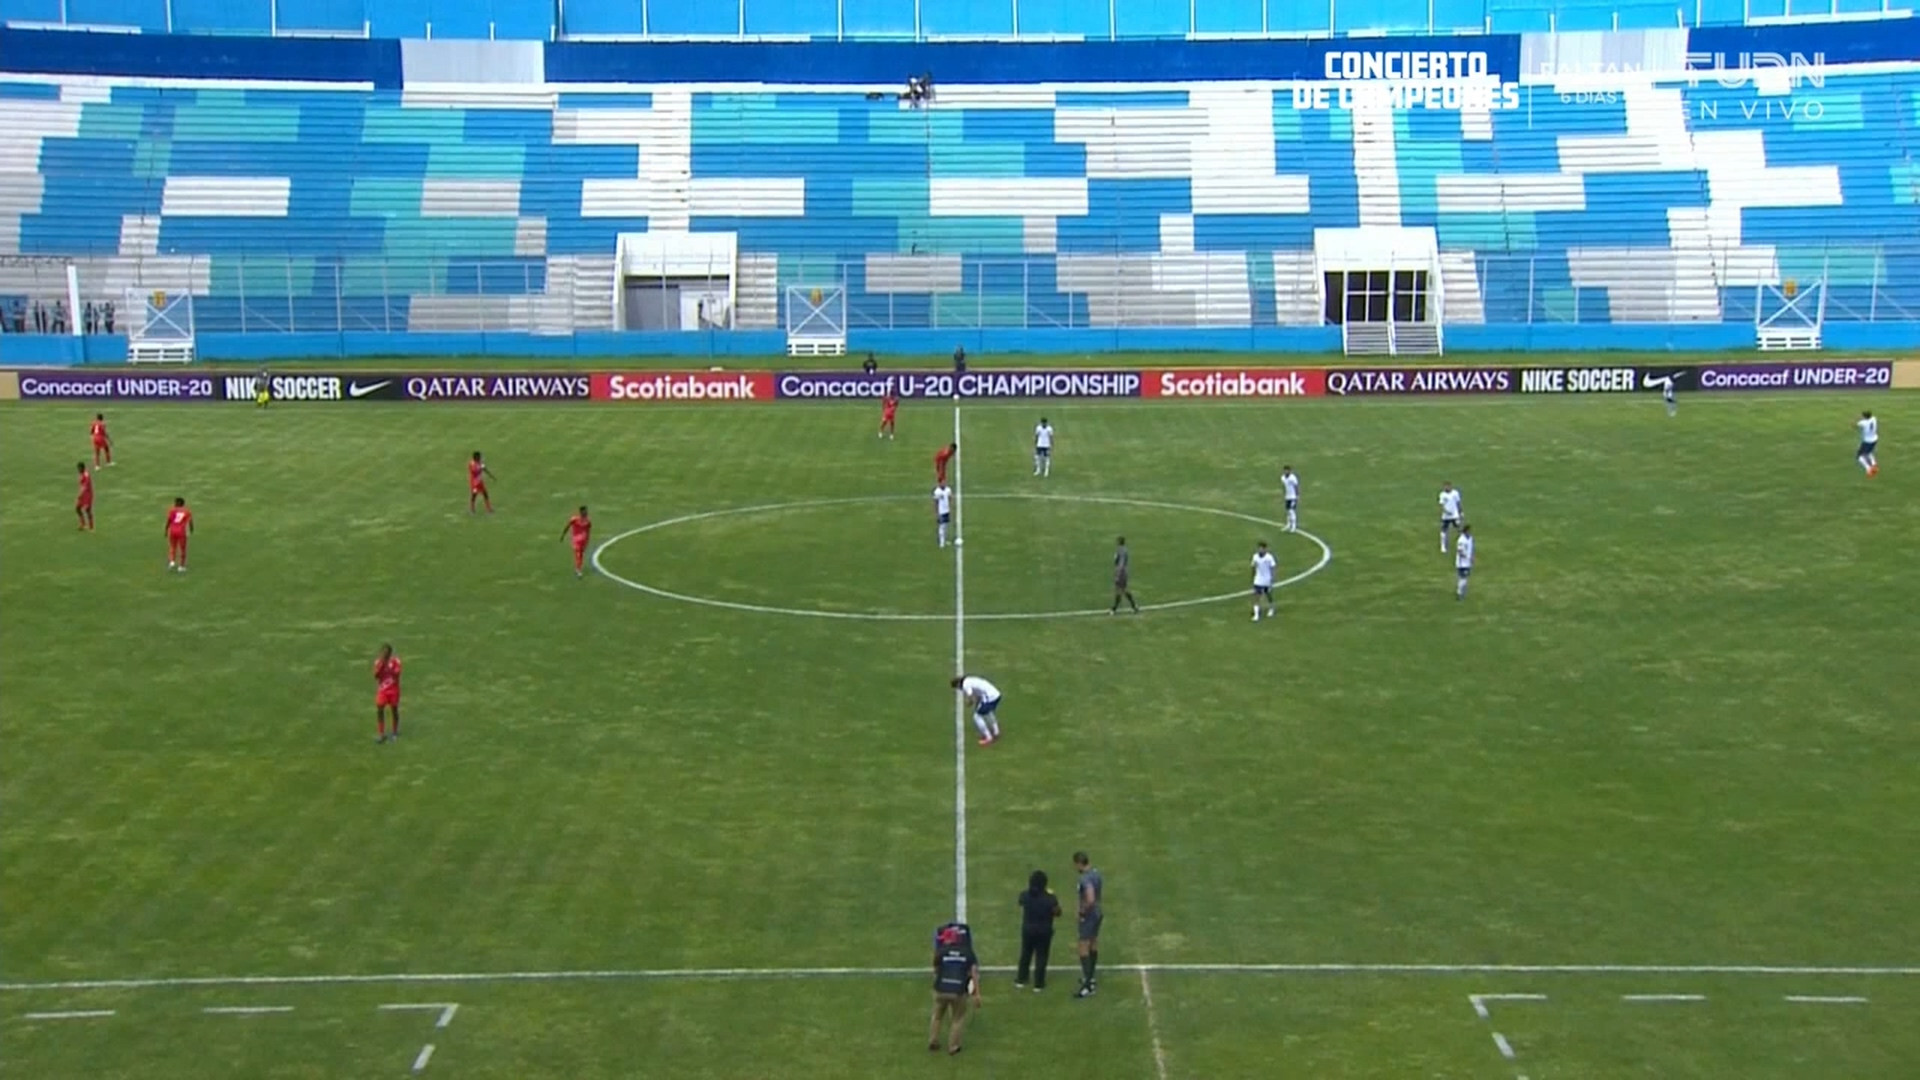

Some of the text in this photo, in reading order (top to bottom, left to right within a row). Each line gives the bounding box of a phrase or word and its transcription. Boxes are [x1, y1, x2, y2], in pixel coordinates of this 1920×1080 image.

[22, 378, 212, 395] Concacaf UNDER-20
[225, 377, 341, 399] NIK SOCCER
[610, 375, 754, 398] Scotiabank
[781, 375, 1139, 396] Concacaf U-20 CHAMPIONSHIP
[1161, 372, 1305, 395] Scotiabank
[1328, 371, 1508, 394] QATAR AIRWAYS
[1521, 369, 1634, 391] NIKE SOCCER
[1701, 367, 1889, 387] Concacaf UNDER-20
[408, 378, 589, 399] QATAR AIRWAYS
